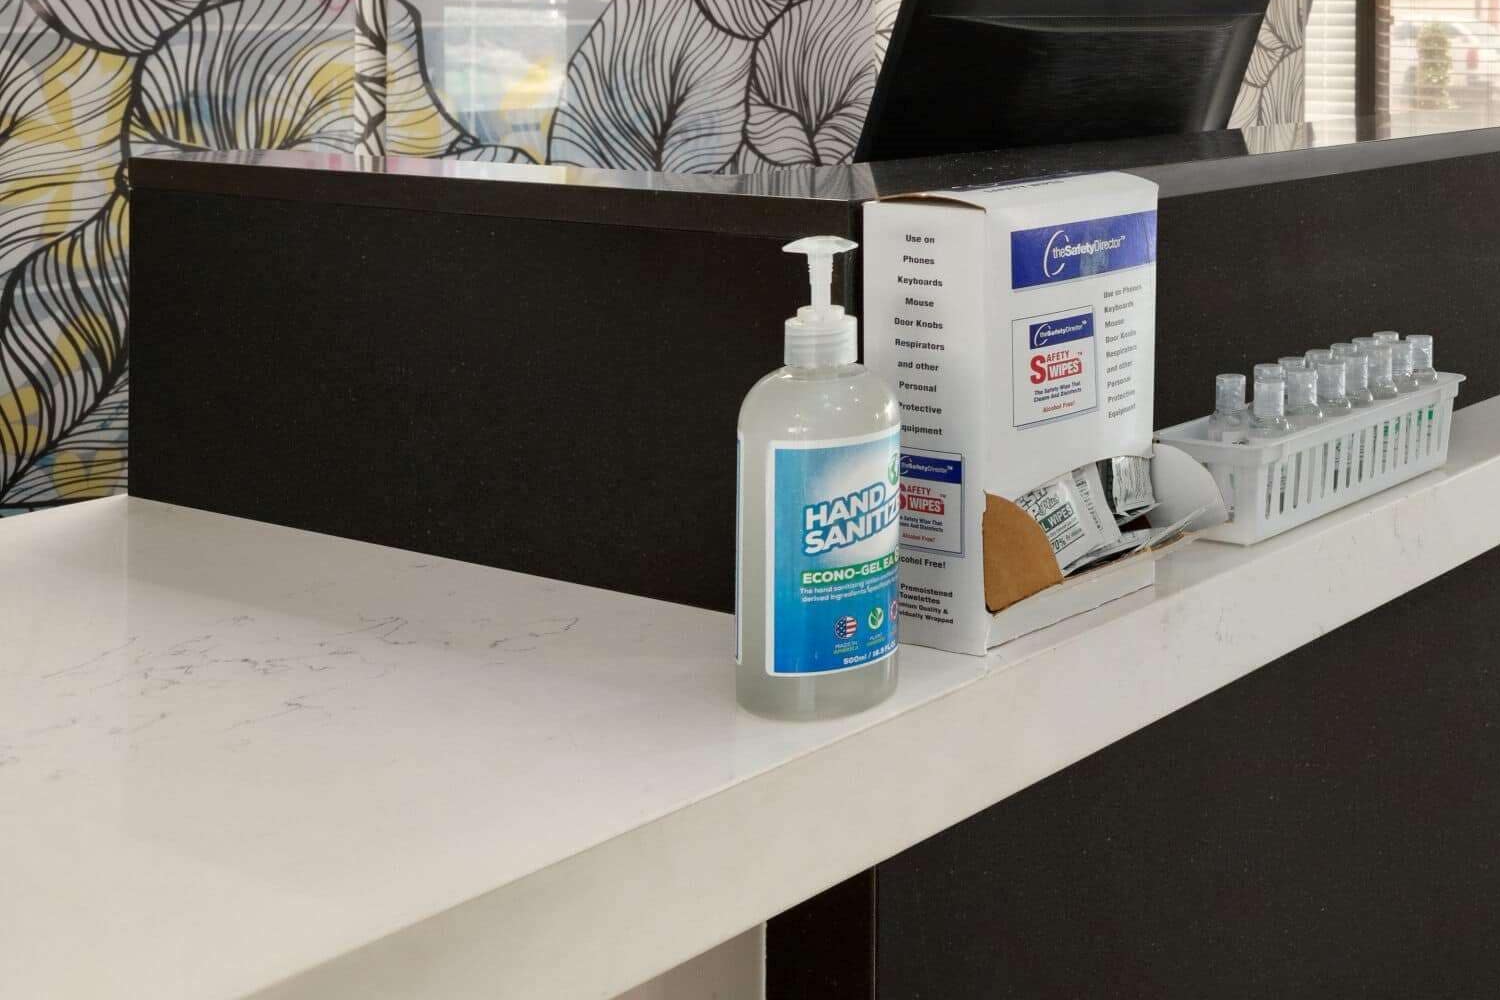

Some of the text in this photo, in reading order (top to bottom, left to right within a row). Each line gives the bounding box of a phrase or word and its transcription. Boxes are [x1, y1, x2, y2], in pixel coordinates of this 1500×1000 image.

[905, 234, 922, 243] Use
[903, 255, 935, 265] Phones
[897, 275, 943, 287] Keyboards
[905, 297, 935, 308] Mouse
[894, 317, 943, 330] Door Knobs
[895, 338, 945, 351] Respirators
[897, 361, 939, 372] and other
[1048, 360, 1082, 380] WIPES
[899, 380, 937, 393] Personal
[901, 424, 943, 436] quipment
[804, 482, 887, 532] HAND
[908, 496, 942, 514] WIPES
[803, 495, 900, 555] SANITIZ
[923, 558, 946, 569] Free!
[802, 560, 882, 585] ECONO-GEL
[900, 583, 953, 598] Premoistened
[899, 591, 940, 604] Towelettes
